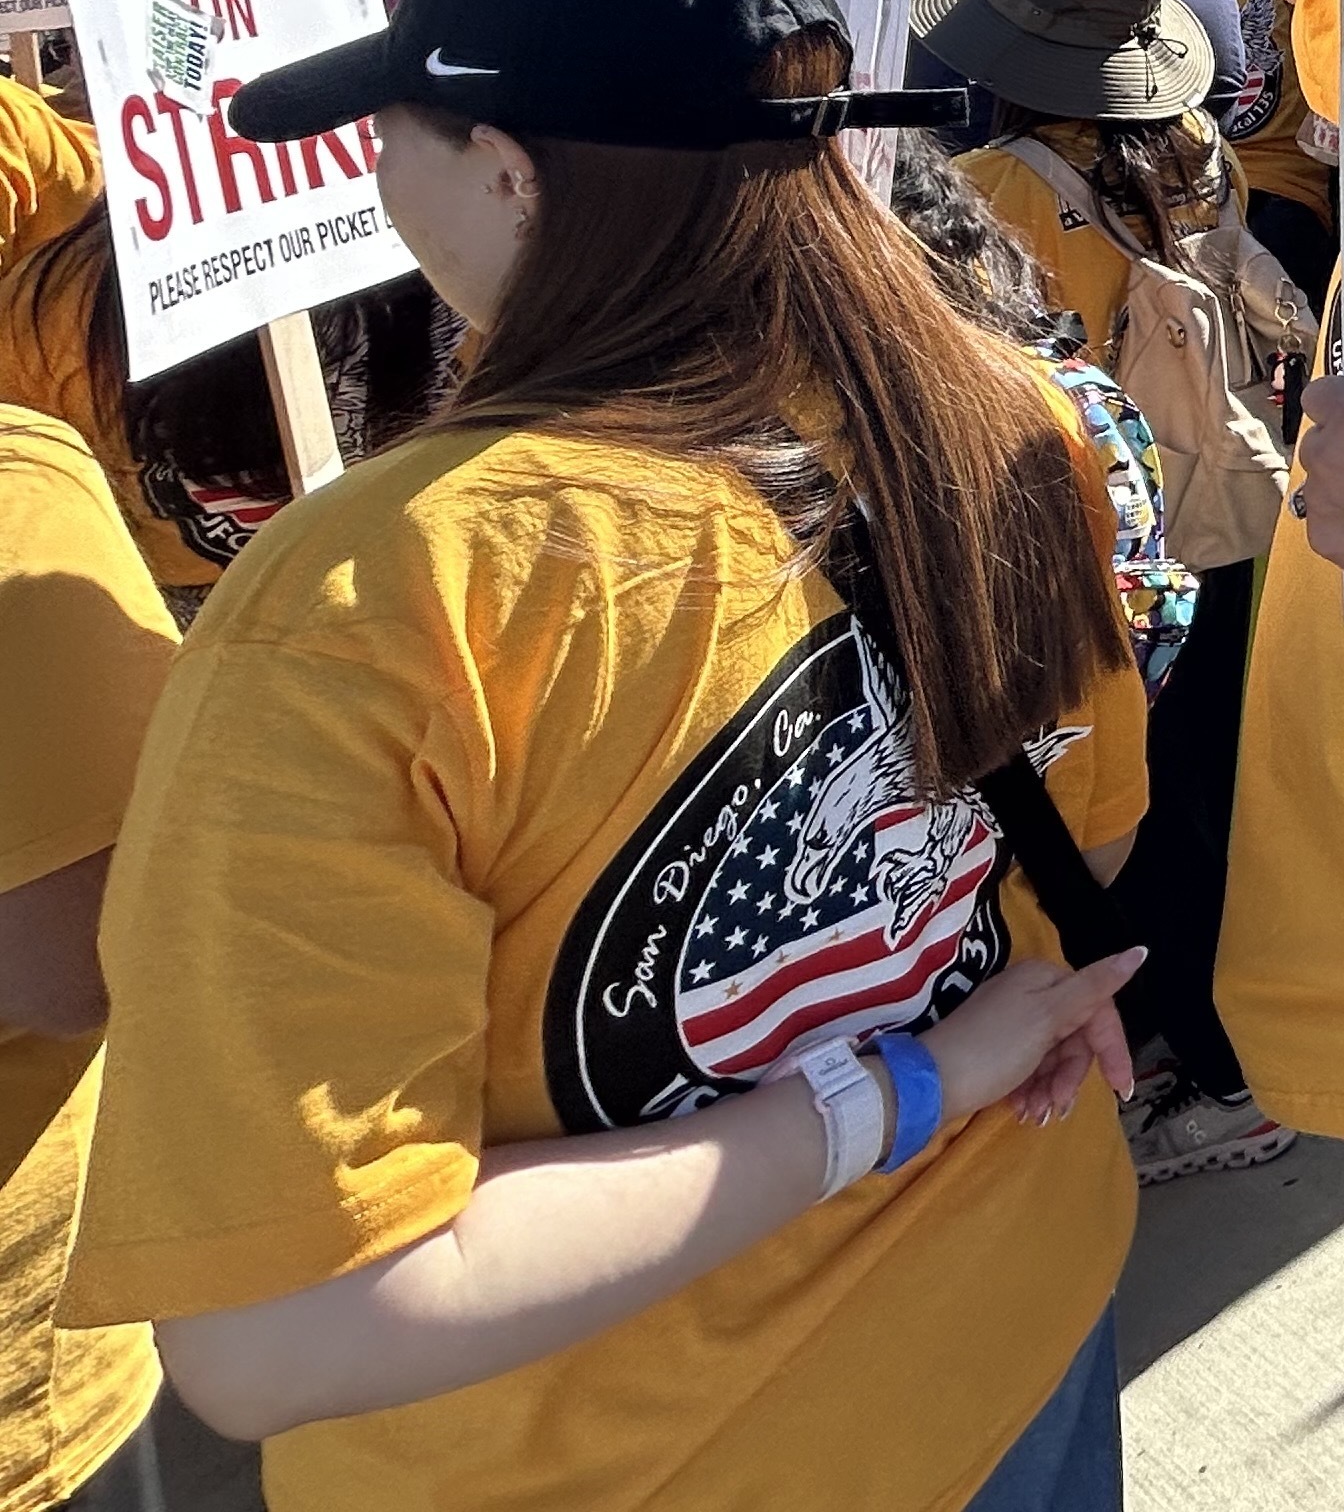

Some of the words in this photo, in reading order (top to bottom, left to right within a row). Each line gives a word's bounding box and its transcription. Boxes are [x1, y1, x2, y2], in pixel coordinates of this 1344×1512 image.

[183, 21, 208, 91] TODAY!
[1253, 89, 1275, 116] 135
[148, 264, 203, 316] PLEASE
[202, 239, 277, 291] RESPECT
[279, 225, 316, 264] OUR
[318, 205, 380, 250] PICKET
[602, 923, 668, 1020] San
[773, 708, 822, 758] Ca.
